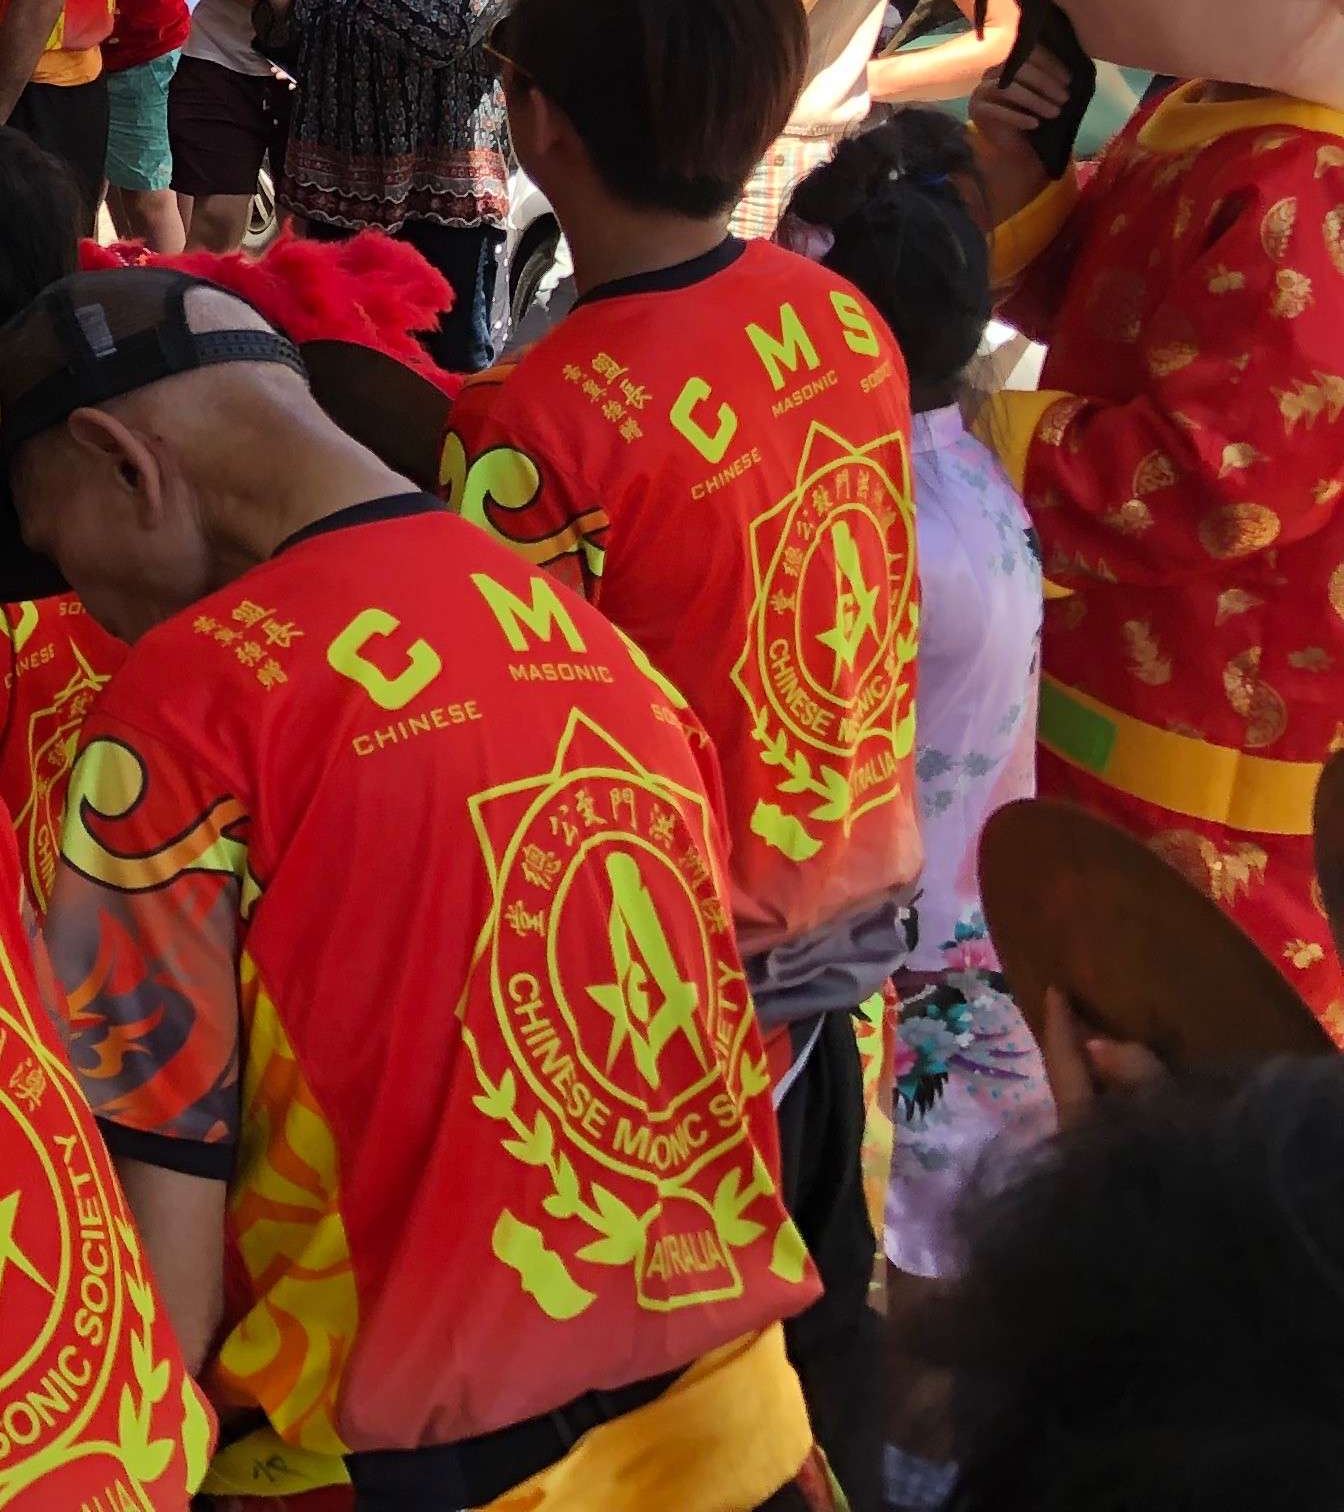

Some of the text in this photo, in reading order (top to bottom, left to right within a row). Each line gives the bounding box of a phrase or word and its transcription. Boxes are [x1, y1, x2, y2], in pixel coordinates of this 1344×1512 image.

[669, 377, 738, 464] C
[745, 302, 820, 391] M
[829, 290, 880, 358] S
[690, 447, 762, 501] CHINESE
[770, 370, 839, 418] MASONIC
[327, 608, 442, 710] C
[470, 572, 587, 653] M
[352, 700, 483, 756] CHINESE
[508, 662, 615, 684] MASONIC
[768, 638, 836, 737] CHINESE
[507, 972, 611, 1142] CHINESE
[74, 1134, 112, 1349] SOCIETY
